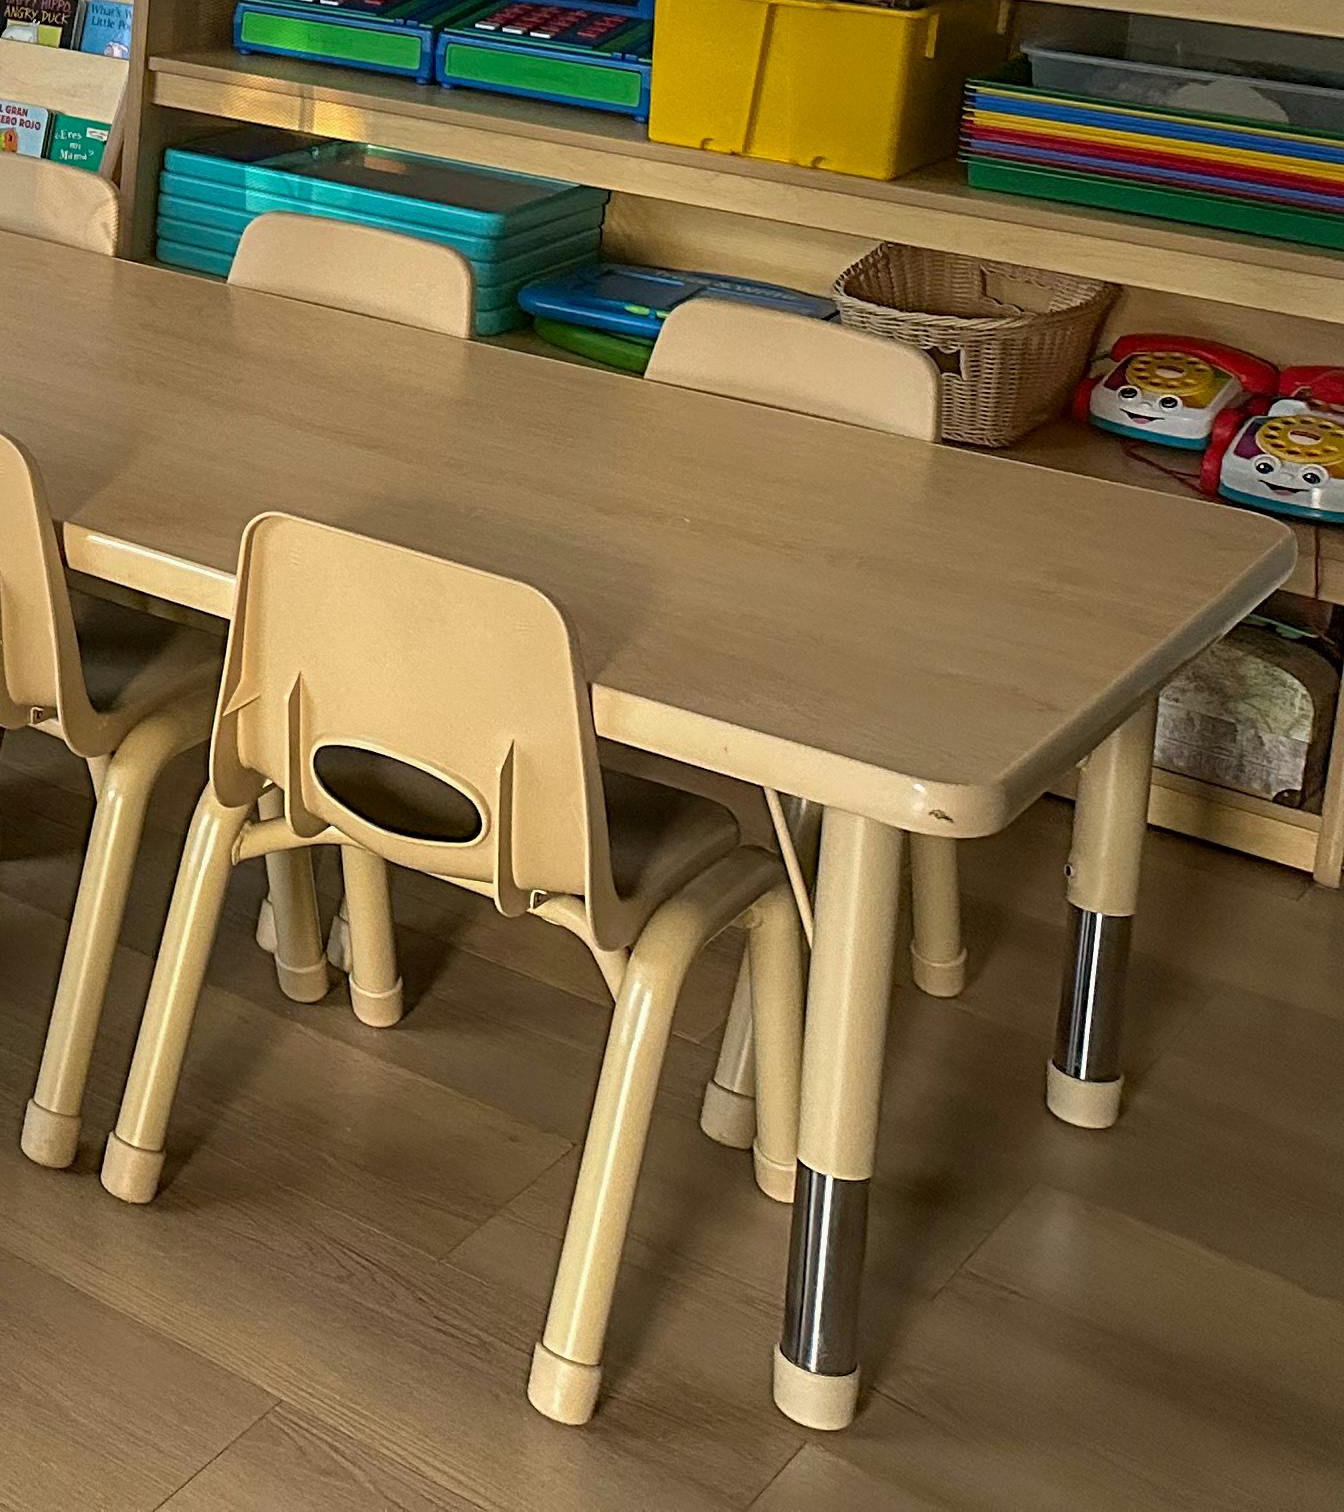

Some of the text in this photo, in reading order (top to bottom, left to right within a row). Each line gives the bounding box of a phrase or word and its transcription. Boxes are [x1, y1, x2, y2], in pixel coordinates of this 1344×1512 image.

[4, 5, 71, 25] ANGRY DUCK
[91, 3, 122, 19] What's
[91, 16, 116, 29] Little
[5, 105, 29, 117] GRAN
[18, 117, 42, 131] ROJO
[54, 128, 83, 140] ¿Eres
[69, 141, 82, 150] mi
